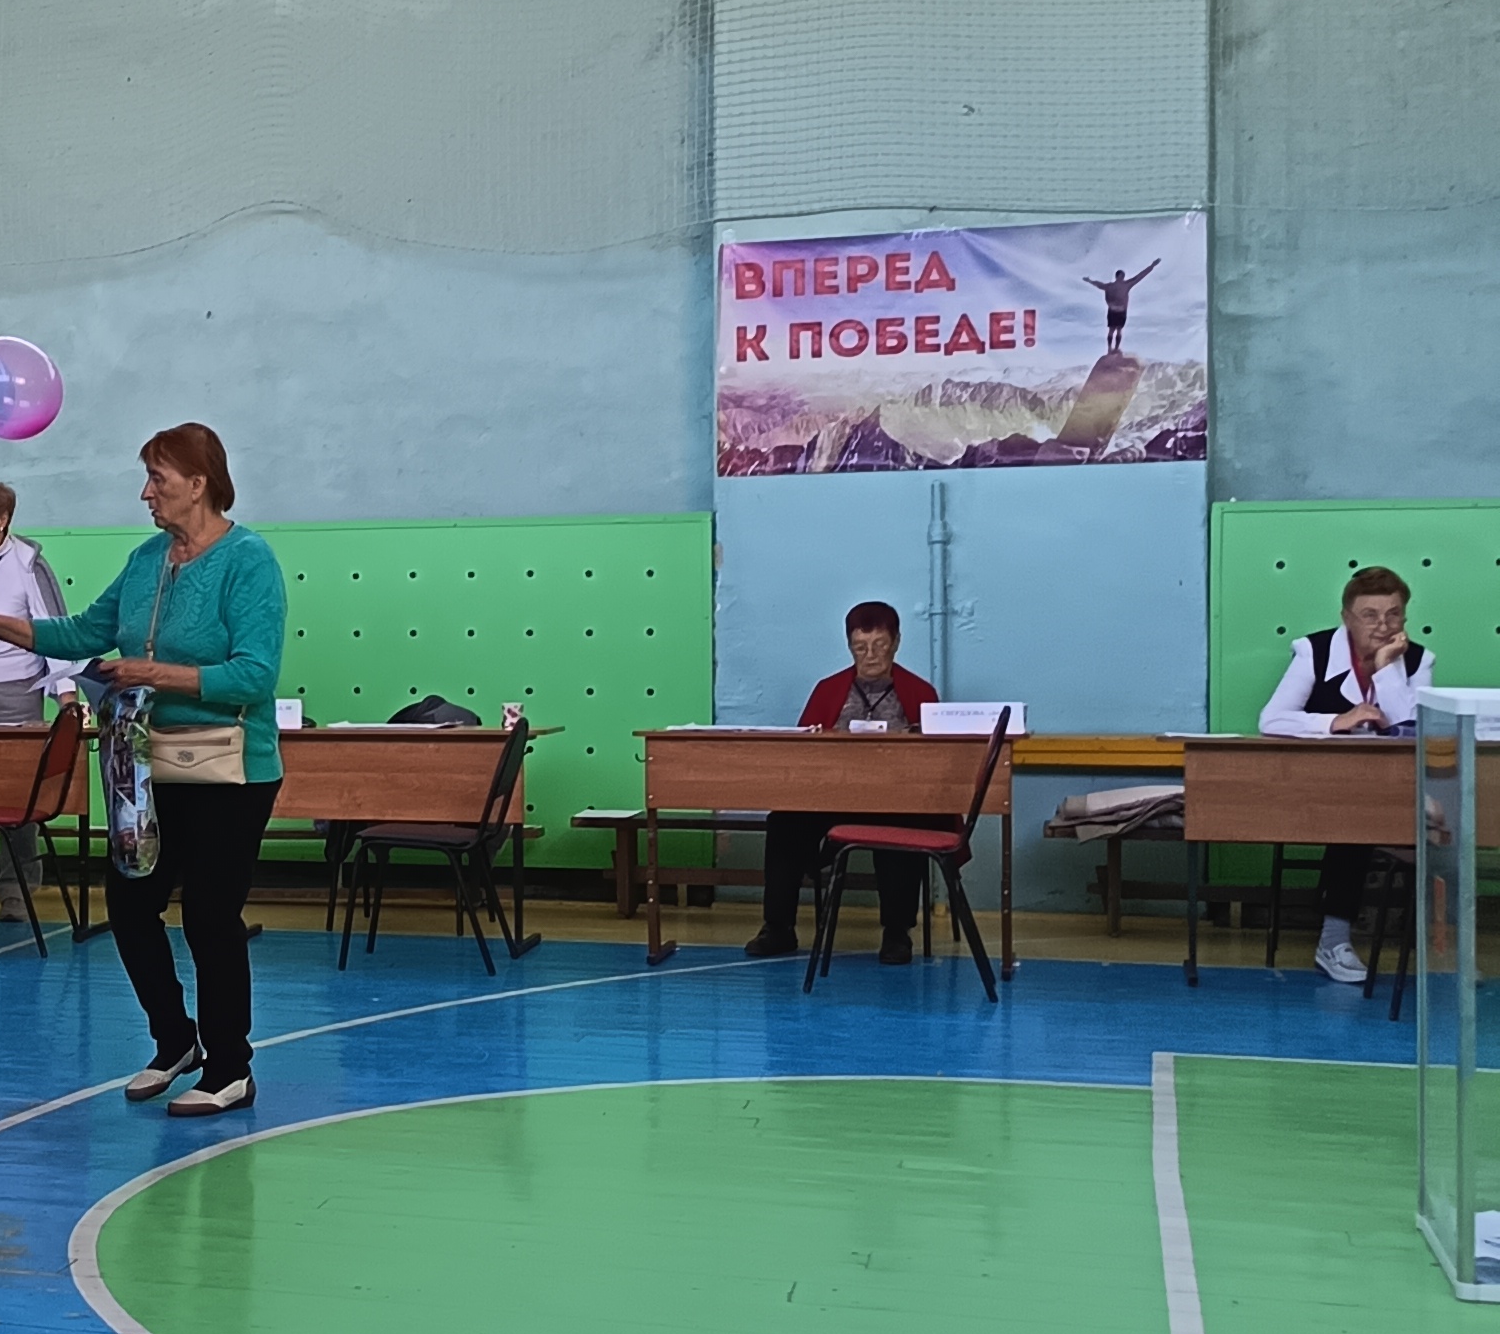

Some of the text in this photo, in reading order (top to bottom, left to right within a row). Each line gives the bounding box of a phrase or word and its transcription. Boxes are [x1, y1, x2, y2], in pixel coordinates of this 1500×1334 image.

[734, 250, 956, 300] ВПЕРЕД
[736, 309, 1037, 362] К ПОБЕДЕ!
